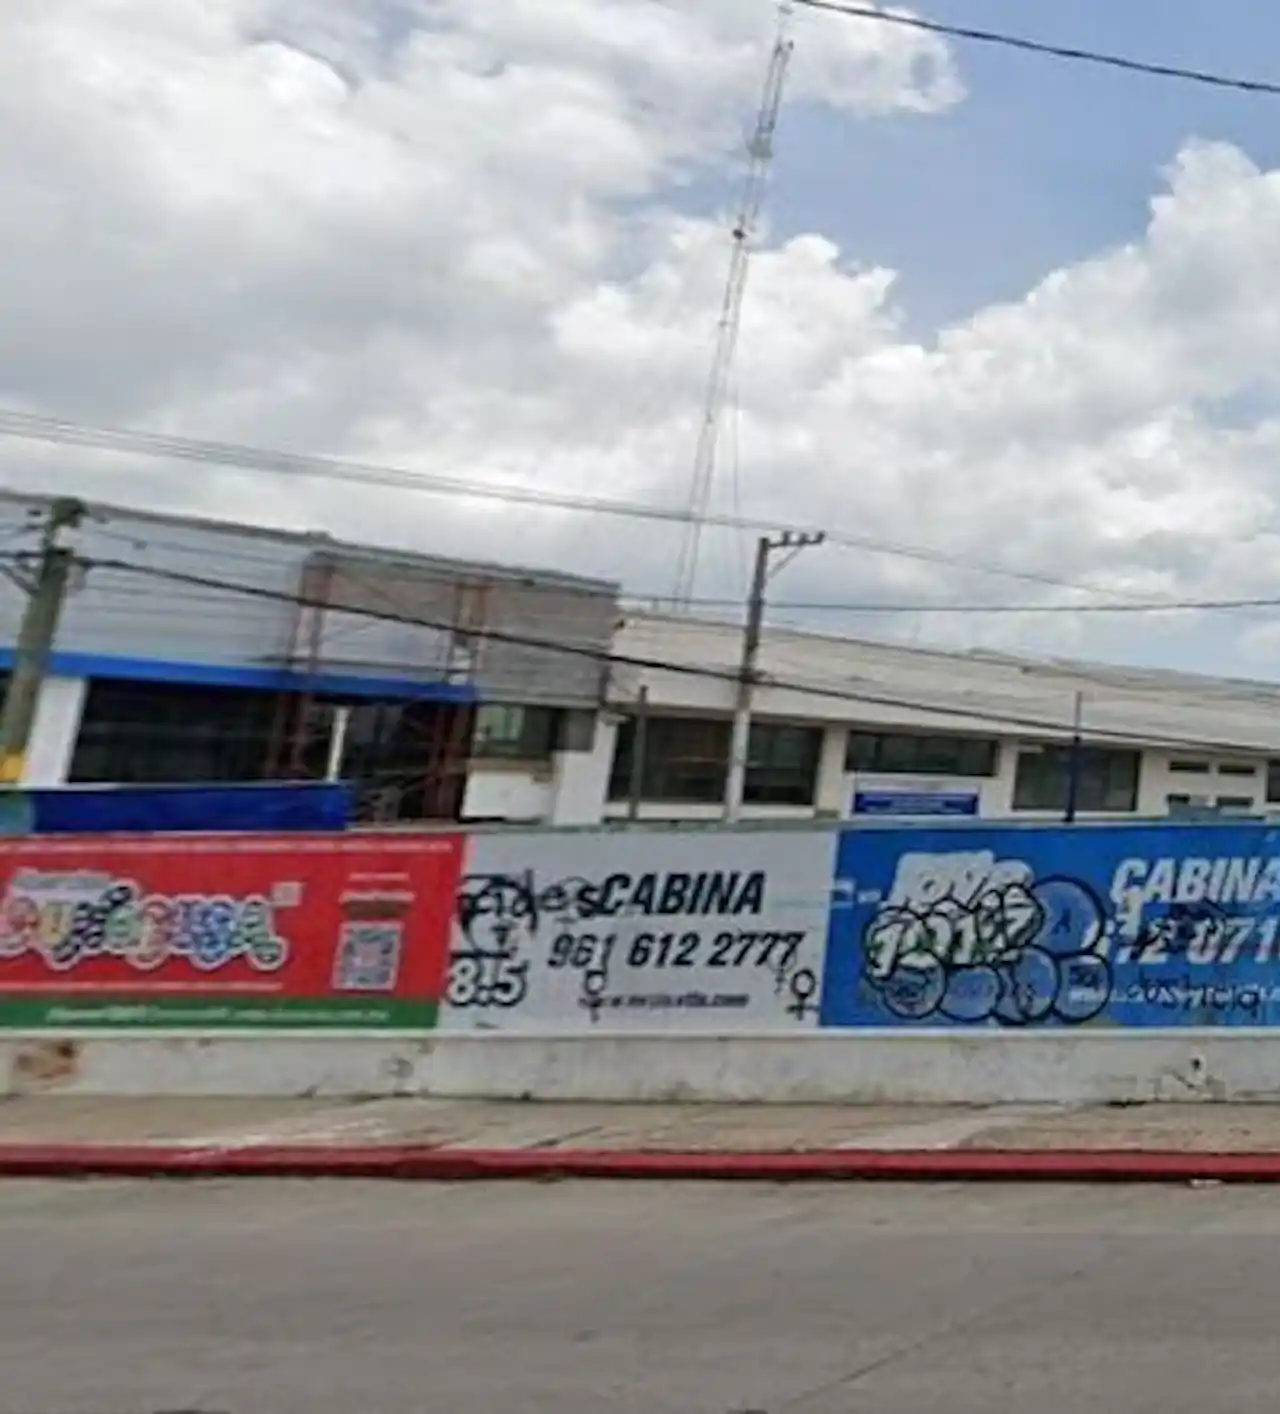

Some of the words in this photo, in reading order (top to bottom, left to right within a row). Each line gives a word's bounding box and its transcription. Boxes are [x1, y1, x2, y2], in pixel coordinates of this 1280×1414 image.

[600, 871, 765, 916] CABINA
[548, 933, 616, 968] 961
[627, 932, 702, 968] 612
[709, 931, 805, 967] 2777
